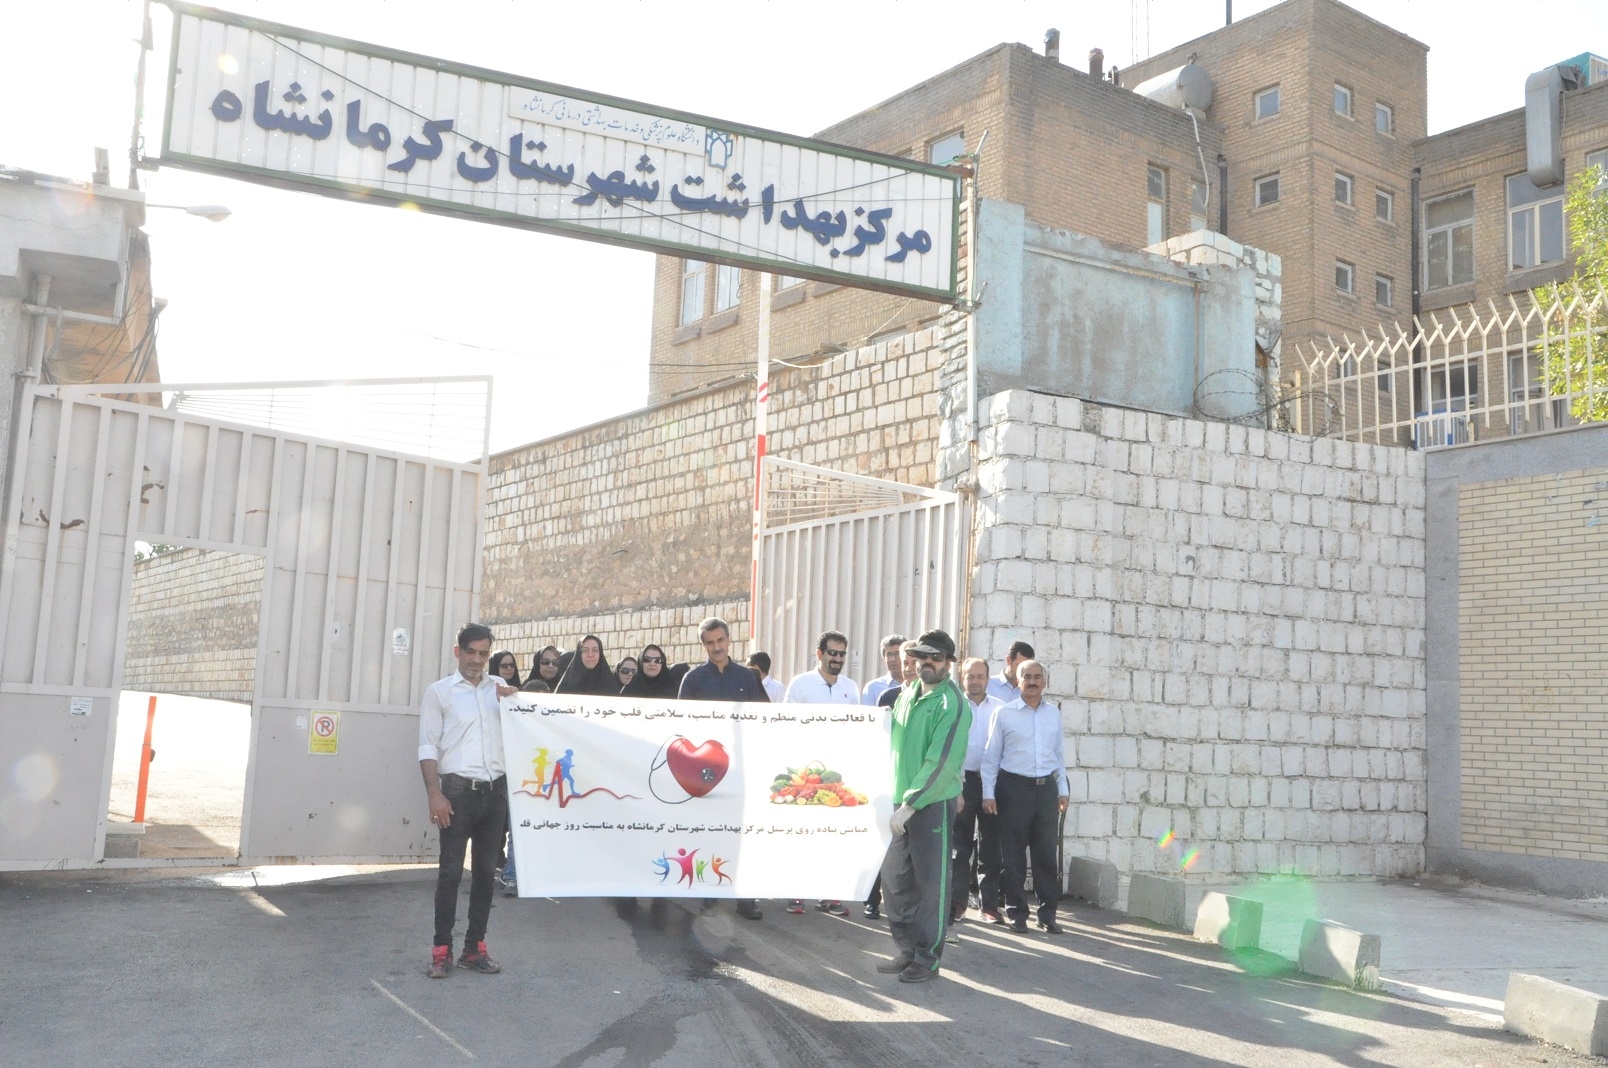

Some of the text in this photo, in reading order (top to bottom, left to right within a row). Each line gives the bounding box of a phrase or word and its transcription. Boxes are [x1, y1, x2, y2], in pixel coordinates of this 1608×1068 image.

[523, 96, 566, 115] کرمانشاه
[555, 102, 581, 121] درمانی
[581, 105, 606, 131] بهداشتی
[607, 119, 639, 133] خدمات
[642, 119, 663, 144] پزشکی
[662, 125, 677, 143] علوم
[677, 124, 700, 146] دانشگاه
[209, 80, 932, 263] مرکز بهداشت شهرستان کرمانشاه
[509, 703, 538, 713] کنید.
[541, 705, 576, 716] تضمین
[580, 705, 590, 718] را
[593, 706, 616, 717] خود
[620, 707, 642, 717] قلب
[644, 708, 684, 720] سلامتی
[729, 711, 758, 723] تغذیه
[770, 712, 797, 724] منظم
[800, 713, 827, 725] بدنی
[830, 713, 865, 725] فعالیت
[868, 714, 876, 724] با
[533, 820, 562, 830] جهانی
[564, 821, 580, 831] روز
[582, 822, 614, 831] مناسبت
[616, 823, 625, 832] به
[627, 822, 666, 832] کرمانشاه
[667, 823, 706, 834] شهرستان
[708, 823, 742, 834] بهداشت
[743, 824, 765, 835] مرکز
[795, 826, 815, 836] روی
[839, 826, 869, 836] همایش
